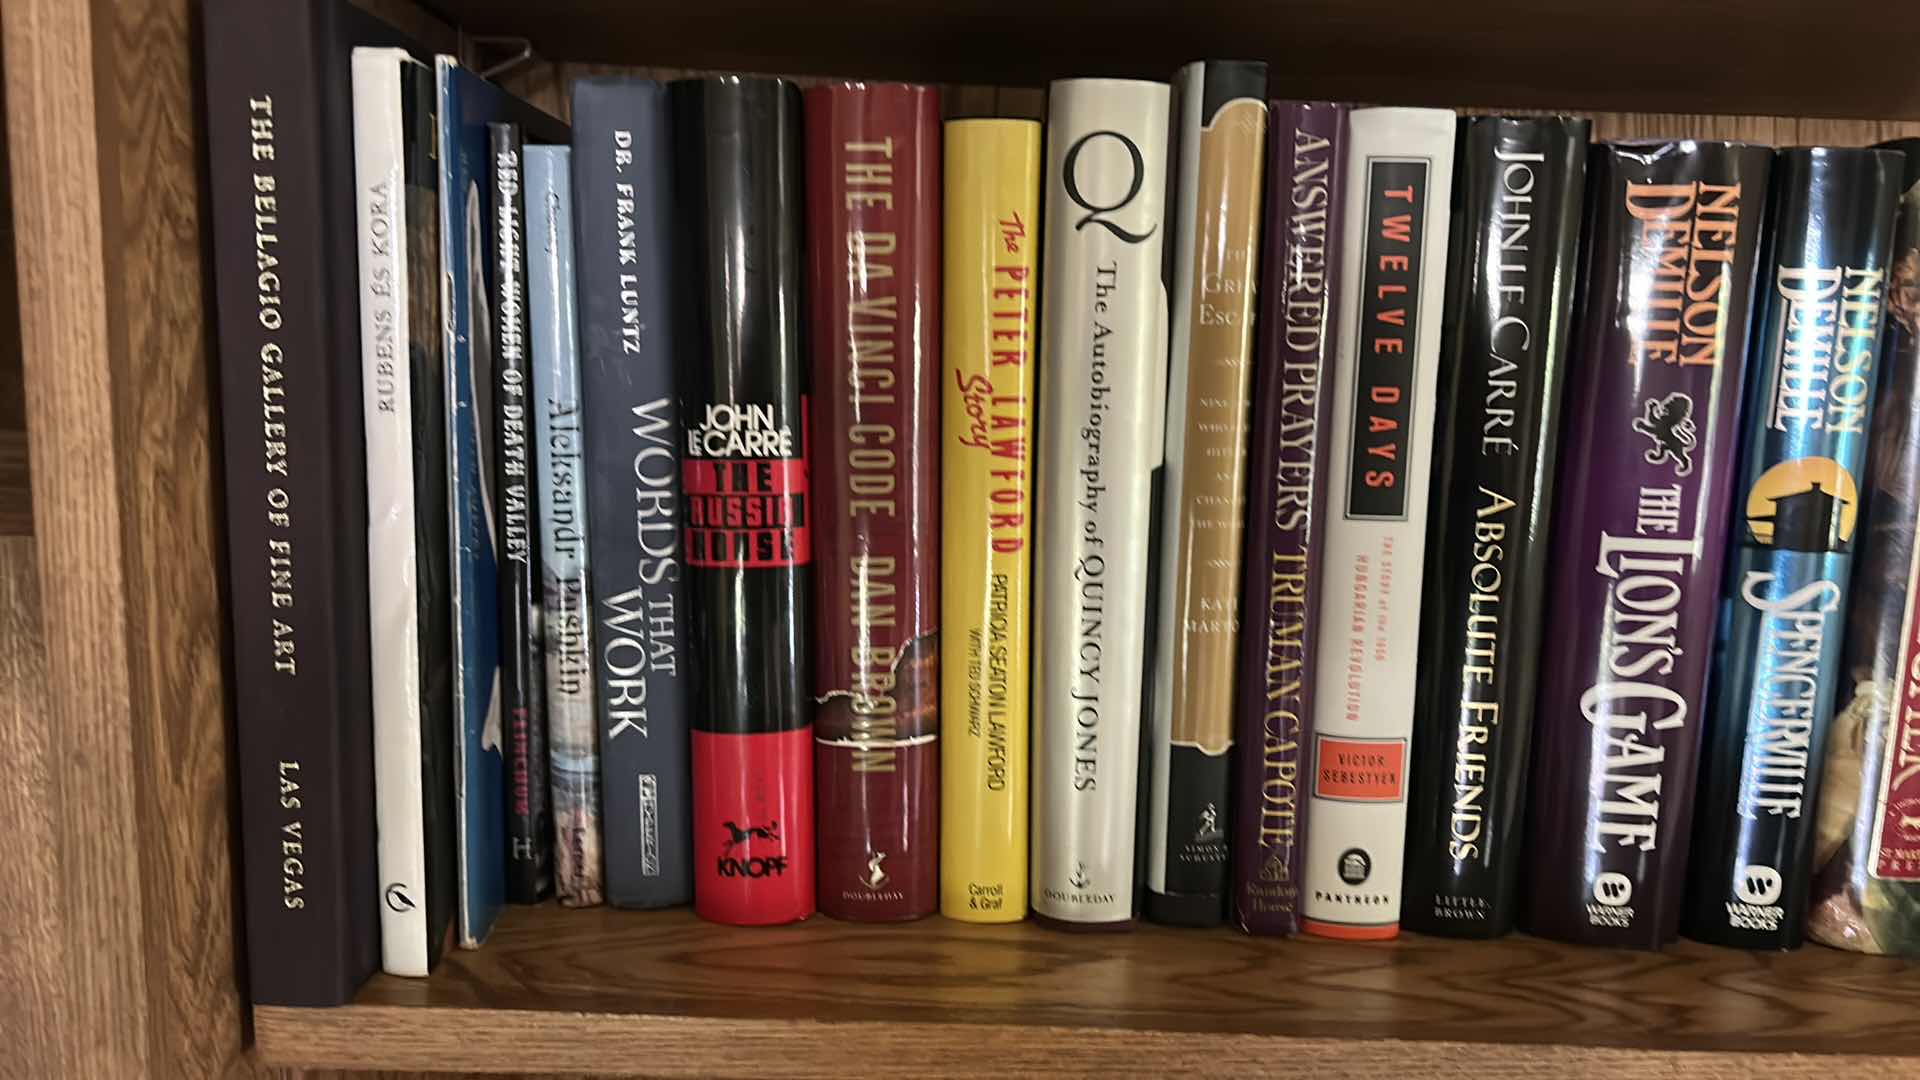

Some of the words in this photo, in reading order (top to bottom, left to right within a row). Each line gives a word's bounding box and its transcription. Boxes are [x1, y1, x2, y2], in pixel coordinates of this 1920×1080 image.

[250, 96, 273, 161] THE
[613, 129, 634, 173] DR.
[845, 137, 894, 212] THE
[1062, 130, 1158, 244] Q
[1494, 146, 1545, 251] JOHN
[253, 174, 283, 330] BELLAGIO
[368, 180, 393, 260] KORA
[616, 182, 638, 265] FRANK
[845, 231, 896, 283] DA
[999, 210, 1026, 253] The
[1284, 128, 1332, 352] ANSWERED
[1094, 260, 1118, 313] The
[1374, 186, 1418, 353] TWELVE
[1498, 260, 1529, 305] LE
[1625, 179, 1698, 367] DEMILLE
[1677, 180, 1742, 367] NELSON
[500, 281, 523, 359] WOMEN
[619, 273, 641, 355] LUNTZ
[846, 295, 897, 406] VINCI
[991, 265, 1030, 367] PETER
[1774, 265, 1843, 433] DEMILLE
[1826, 266, 1884, 434] NELSON
[370, 310, 396, 415] RUBENS
[502, 370, 525, 397] OF
[1481, 315, 1531, 457] CARRÉ
[260, 343, 288, 477] GALLERY
[503, 405, 526, 477] DEATH
[699, 403, 774, 432] JOHN
[955, 368, 994, 450] Story
[1078, 320, 1113, 513] Autobiography
[1274, 359, 1320, 532] PRAYERS
[1364, 385, 1401, 488] DAYS
[267, 488, 290, 528] OF
[548, 398, 584, 559] Aleksandr
[631, 398, 680, 584] WORDS
[713, 463, 772, 492] THE
[848, 423, 897, 519] CODE
[990, 396, 1027, 554] LAWFORD
[1635, 485, 1683, 535] THE
[505, 485, 528, 564] VALLEY
[1084, 520, 1104, 546] of
[269, 539, 293, 608] FINE
[849, 556, 897, 625] DAN
[990, 574, 1009, 642] PATRICIA
[1351, 554, 1370, 632] HUNGARIAN
[1462, 486, 1517, 685] ABSOLUTE
[272, 619, 296, 676] ART
[556, 577, 589, 696] Pushkin
[648, 592, 677, 677] THAT
[968, 627, 982, 657] WITH
[1074, 555, 1105, 685] QUINCY
[1266, 544, 1309, 702] TRUMAN
[602, 586, 648, 740] WORK
[989, 645, 1008, 707] SEATON
[1345, 638, 1365, 722] REVOLUTION
[1737, 570, 1841, 820] SPENCERVILLE
[850, 645, 897, 773] BROWN
[1071, 690, 1101, 792] JONES
[279, 760, 300, 809] LAS
[987, 711, 1007, 792] LAWFORD
[1260, 711, 1300, 848] CAPOTE
[1322, 768, 1397, 785] SEBESTYEN
[1337, 753, 1386, 768] VICTOR
[1447, 700, 1500, 864] FRIENDS
[1580, 681, 1689, 855] GAME
[282, 821, 305, 910] VEGAS
[718, 855, 788, 878] KNOPF
[968, 882, 1004, 897] Carroll
[968, 897, 978, 910] &
[980, 896, 1003, 911] Graf
[1044, 887, 1116, 905] DOUBLEDAY
[1246, 882, 1297, 897] Random
[1251, 898, 1293, 913] House
[1315, 890, 1390, 905] PANTHEON
[1434, 906, 1486, 921] BROWN
